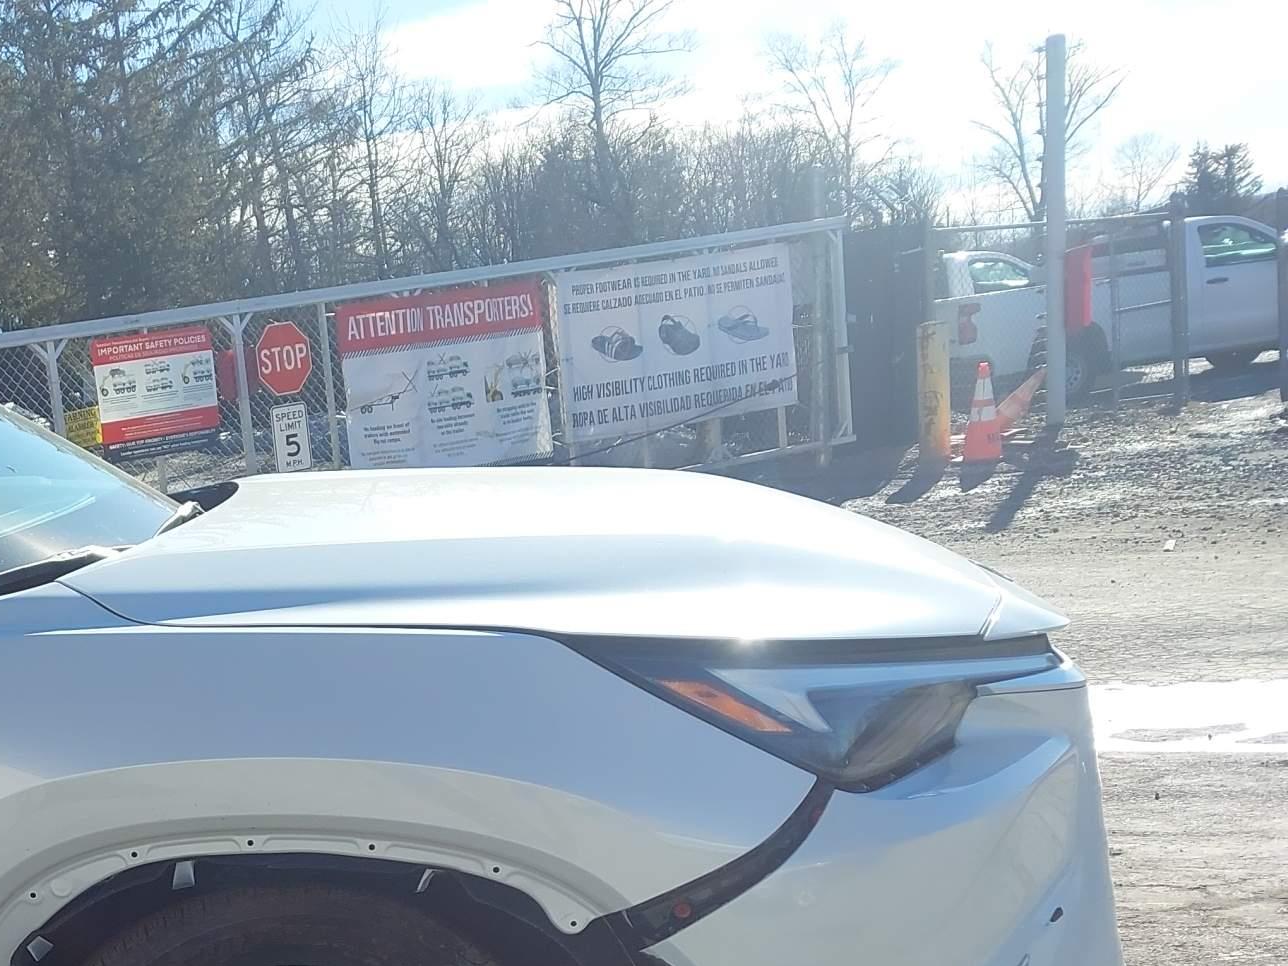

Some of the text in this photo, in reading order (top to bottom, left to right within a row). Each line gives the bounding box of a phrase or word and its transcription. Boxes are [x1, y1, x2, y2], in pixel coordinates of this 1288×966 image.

[572, 283, 595, 296] PROPER
[596, 278, 632, 294] FOOTWEAR
[634, 276, 640, 288] IS
[641, 273, 668, 287] REQUIRED
[669, 271, 676, 283] IN
[677, 269, 692, 281] THE
[564, 303, 571, 315] SE
[601, 296, 633, 310] CALZADO
[665, 290, 674, 302] EN
[675, 288, 683, 300] EL
[347, 294, 534, 341] ATTENTION TRANSPORTERS!
[97, 342, 143, 357] IMPORTANT
[145, 339, 172, 350] SAFETY
[173, 334, 206, 345] POLICIES
[260, 343, 306, 374] STOP
[573, 383, 593, 402] HIGH
[596, 377, 645, 399] VISIBILITY
[647, 369, 691, 391] CLOTHING
[693, 361, 737, 383] REQUIRED
[739, 359, 748, 376] IN
[749, 355, 767, 373] THE
[275, 410, 304, 422] SPEED
[572, 410, 595, 429] ROPA
[597, 408, 609, 425] DE
[612, 404, 637, 423] ALTA
[638, 394, 692, 418] VISIBILIDAD
[279, 420, 302, 432] LIMIT
[286, 433, 301, 457] 5
